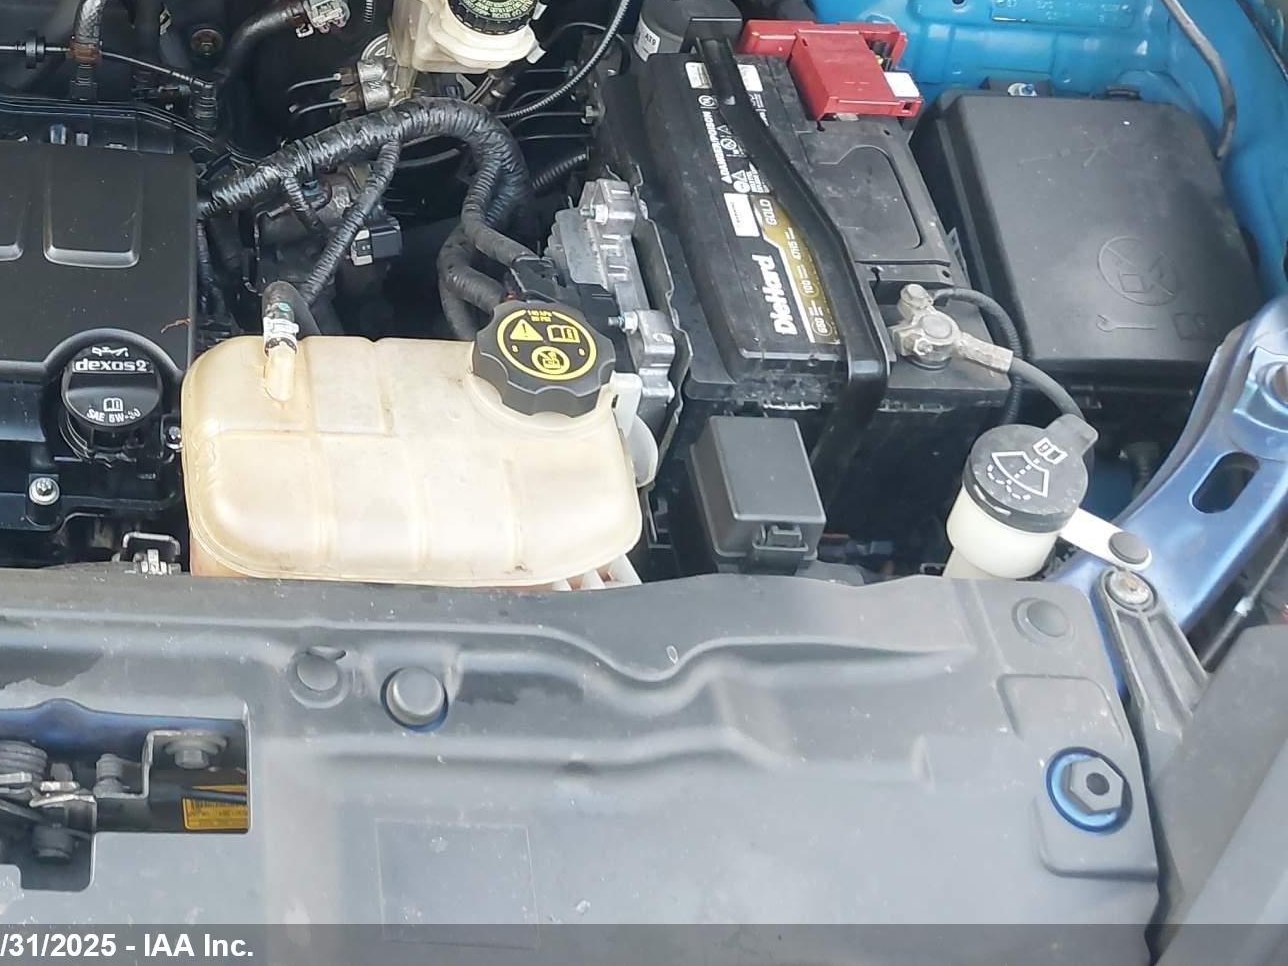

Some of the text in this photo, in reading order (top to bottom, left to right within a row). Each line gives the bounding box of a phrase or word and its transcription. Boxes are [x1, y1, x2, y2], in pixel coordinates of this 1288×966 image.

[759, 198, 778, 226] GOLD
[751, 254, 798, 335] DieHard
[75, 358, 147, 372] dexos2
[86, 408, 105, 422] SAE
